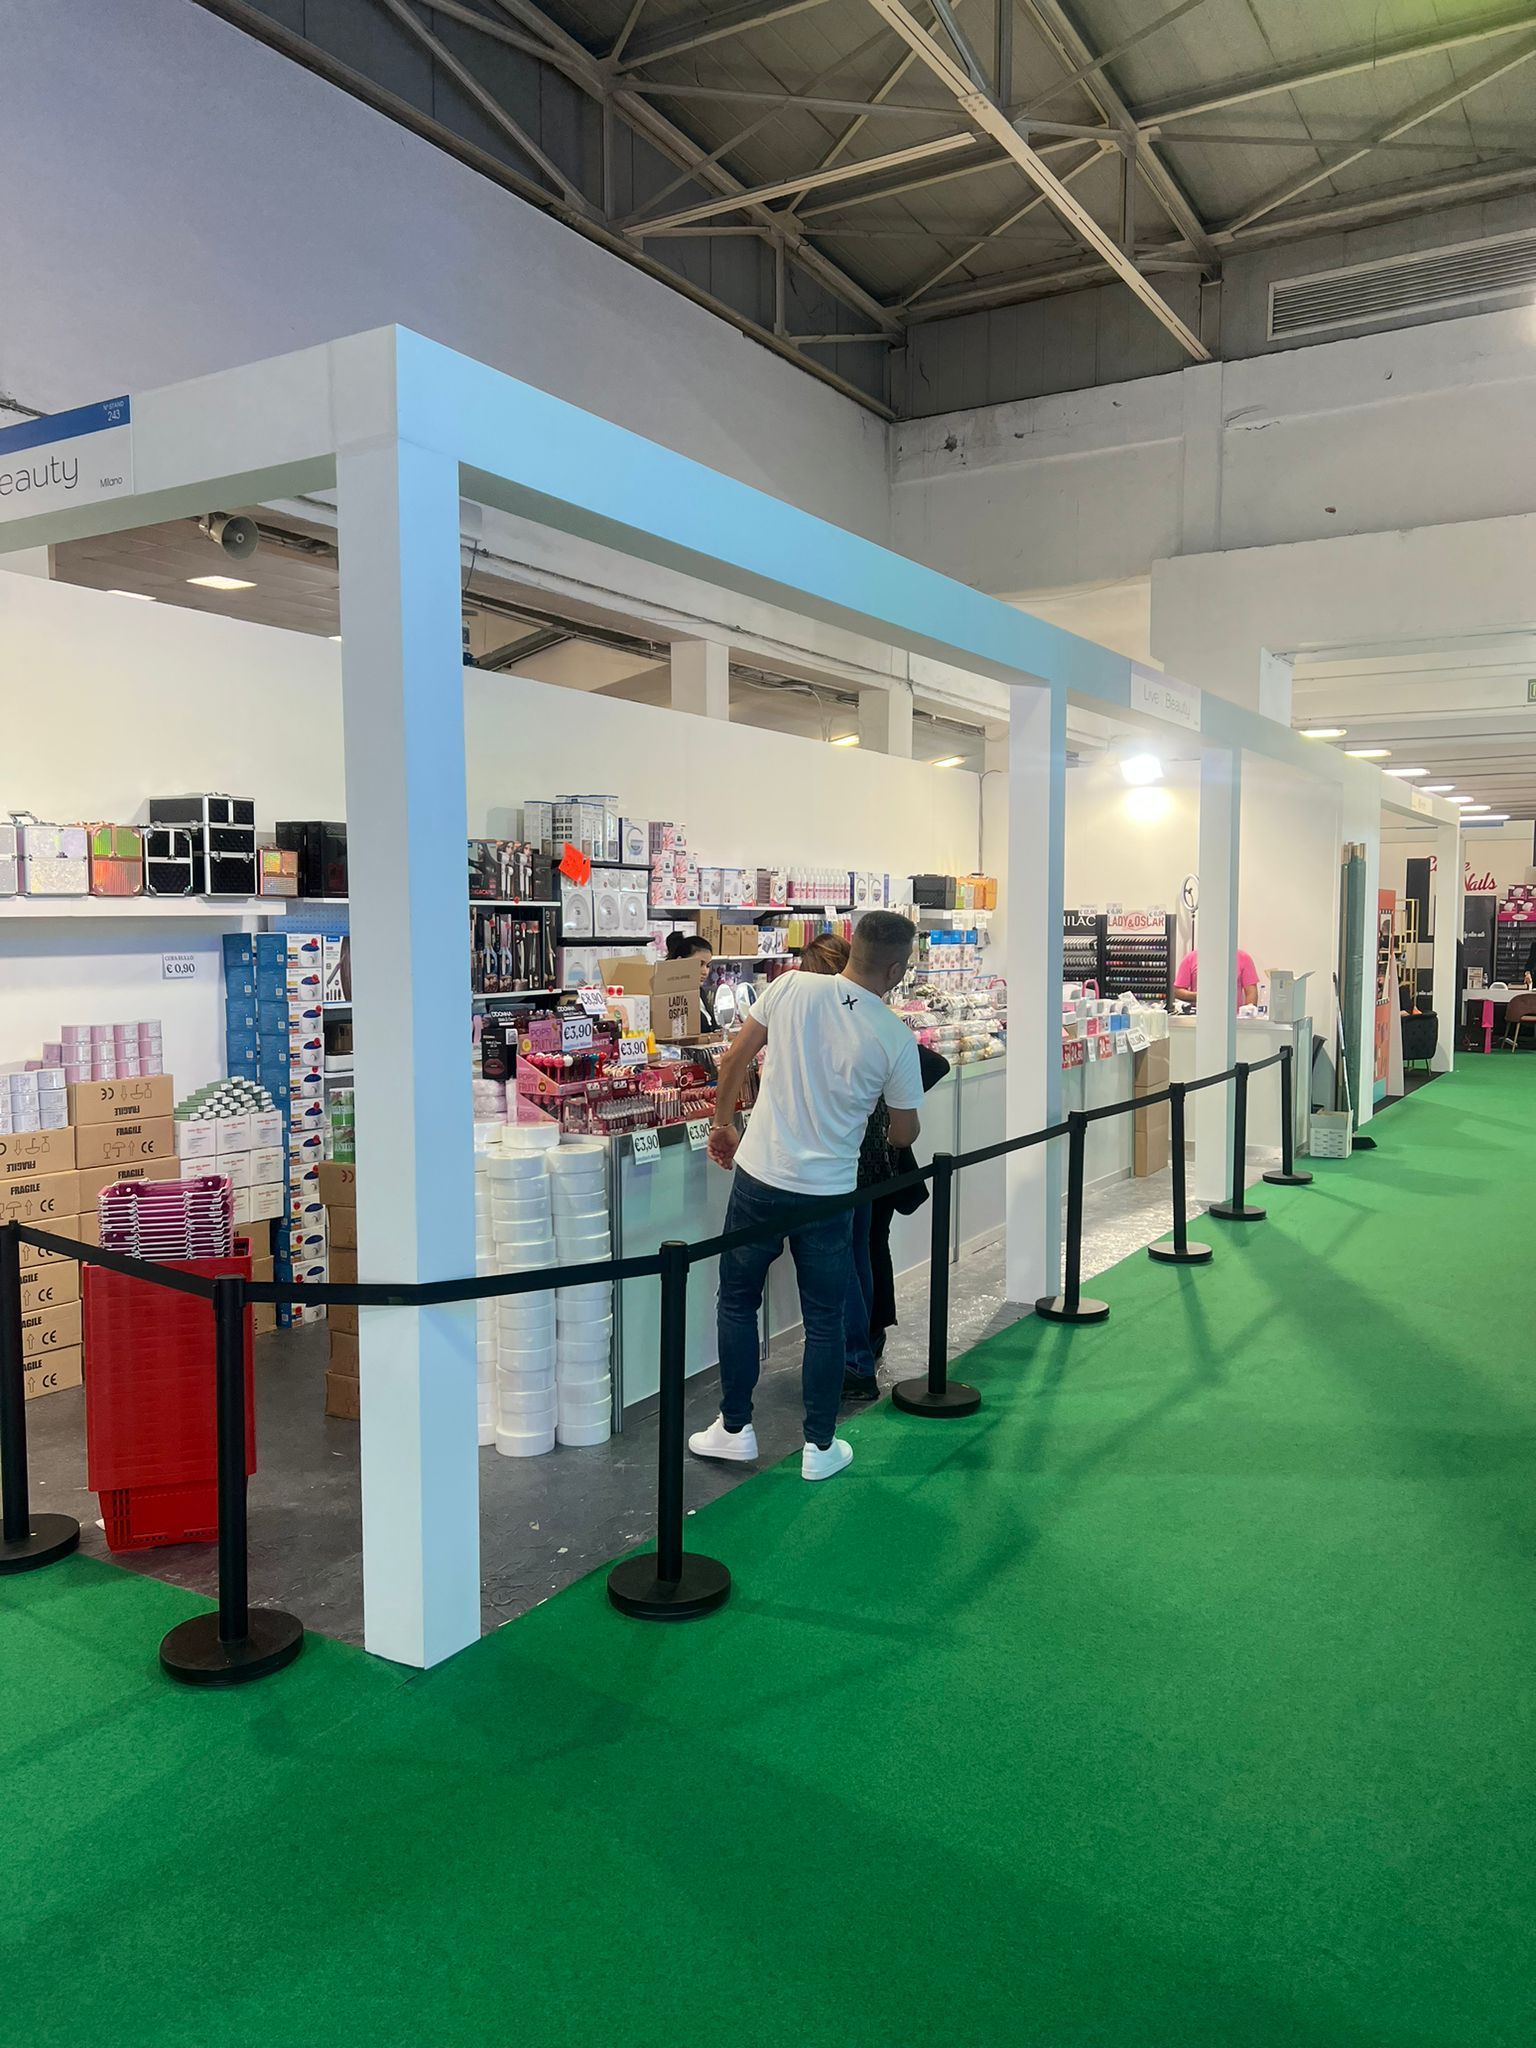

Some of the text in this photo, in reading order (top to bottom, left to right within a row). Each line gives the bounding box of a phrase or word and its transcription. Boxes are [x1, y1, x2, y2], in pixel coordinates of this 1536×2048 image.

[107, 409, 120, 421] 243
[0, 456, 78, 495] eauty
[100, 477, 123, 488] Milano
[174, 963, 196, 974] 0,90
[564, 1023, 592, 1040] €3,90
[620, 1040, 646, 1056] €3,90
[114, 1105, 140, 1116] FRAGILE
[116, 1125, 141, 1136] FRAGILE
[635, 1134, 658, 1152] €3,90
[6, 1160, 36, 1172] FRAGILE
[118, 1168, 144, 1179] FRAGILE
[10, 1183, 40, 1195] FRAGILE
[20, 1272, 39, 1285] AGILE
[21, 1316, 42, 1328] AGILE
[23, 1359, 42, 1372] AGILE
